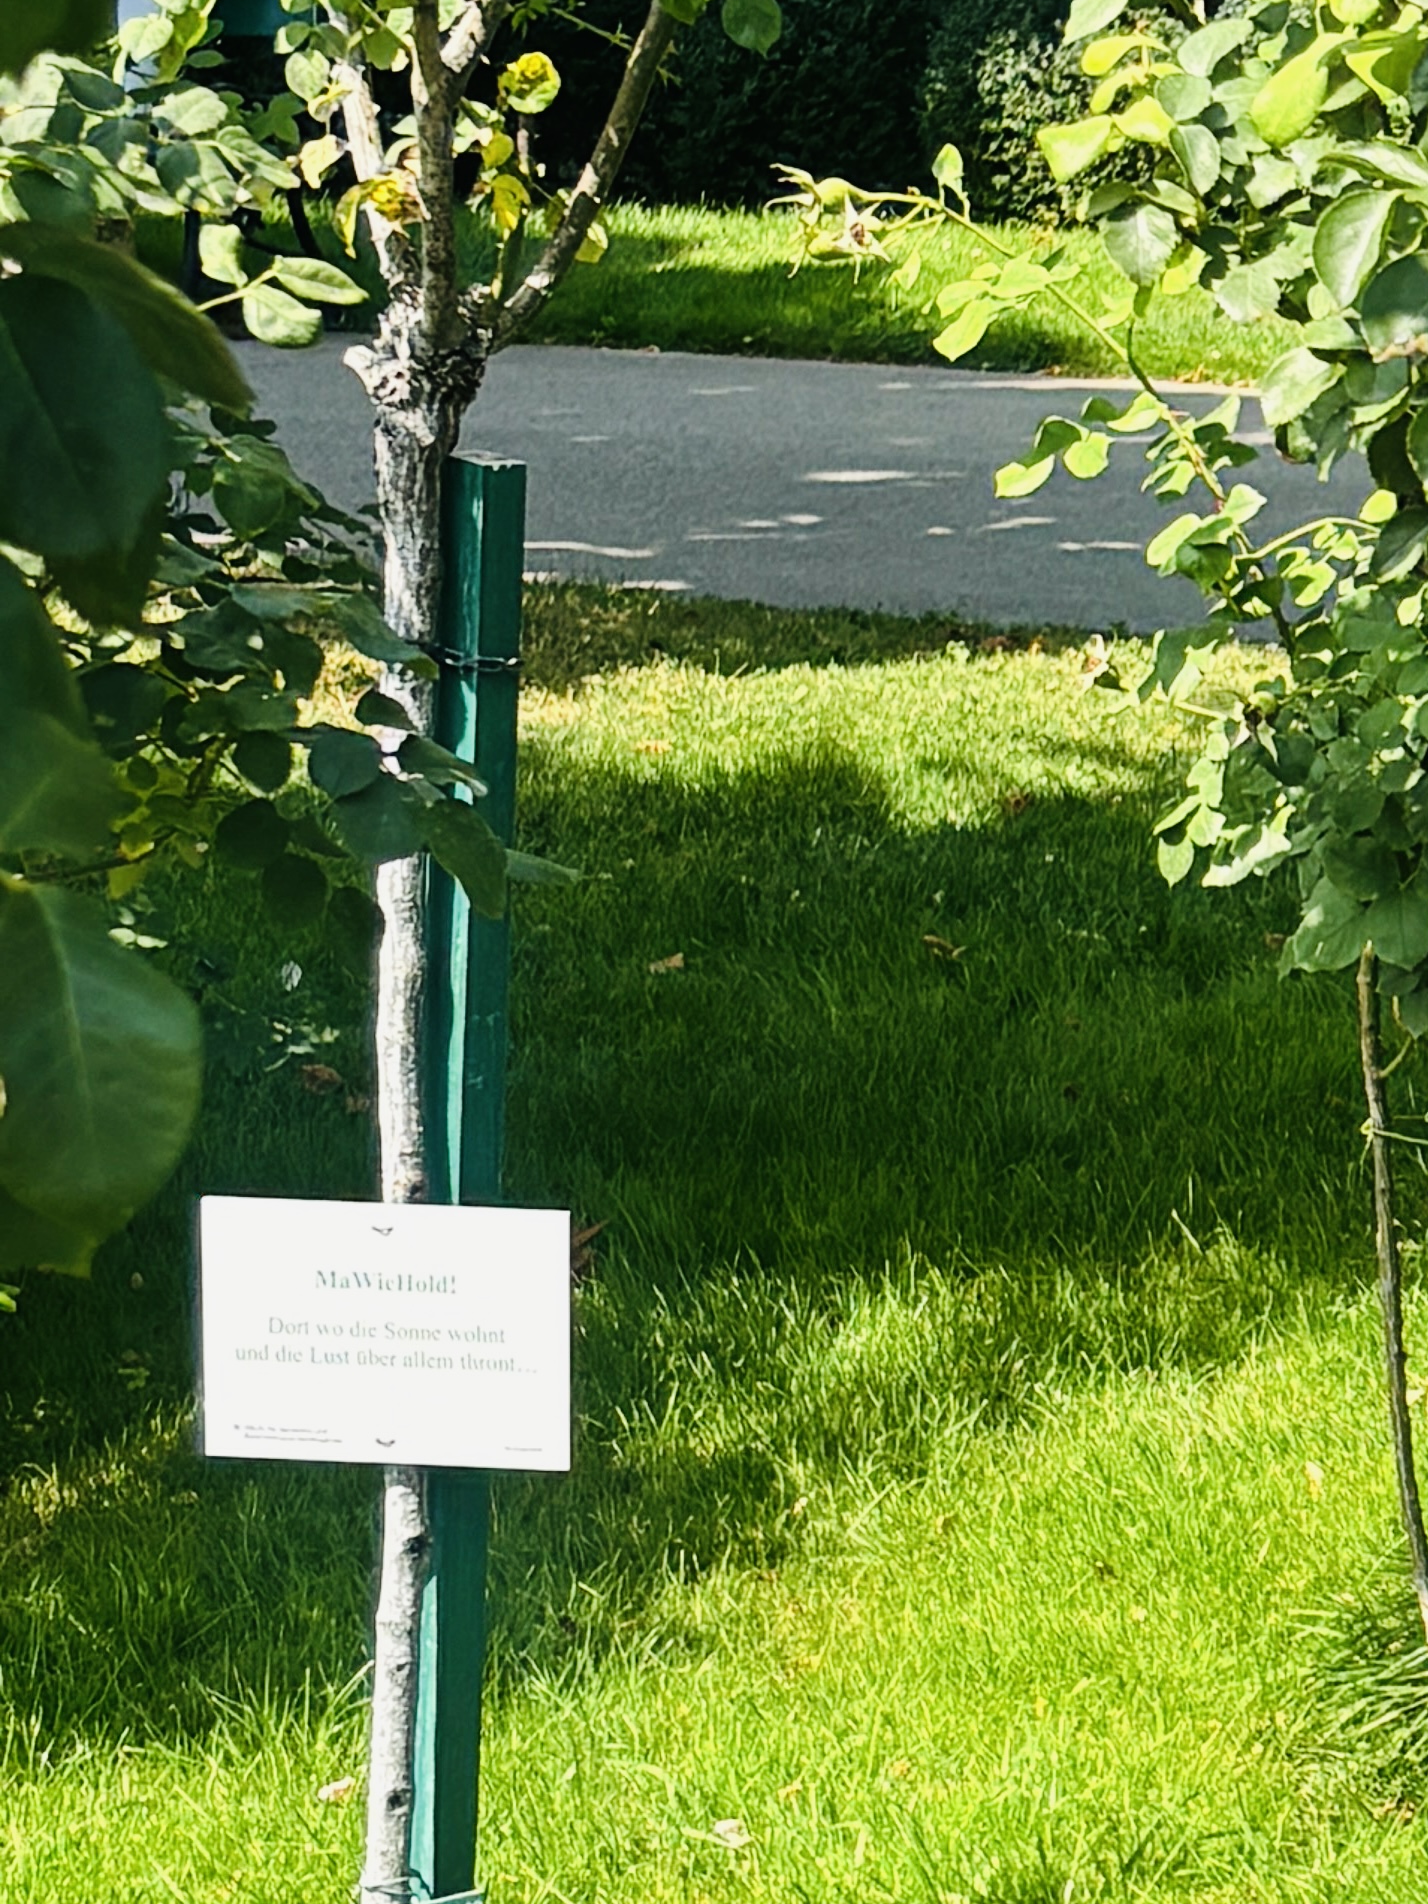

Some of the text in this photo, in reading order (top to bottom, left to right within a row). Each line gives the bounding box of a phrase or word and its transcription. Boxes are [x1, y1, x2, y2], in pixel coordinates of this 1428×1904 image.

[268, 1316, 506, 1344] Dort wo die Sonne wohnt
[235, 1345, 269, 1362] und
[275, 1347, 303, 1363] die
[310, 1346, 350, 1365] Lust
[357, 1350, 397, 1368] über
[403, 1351, 454, 1370] allem
